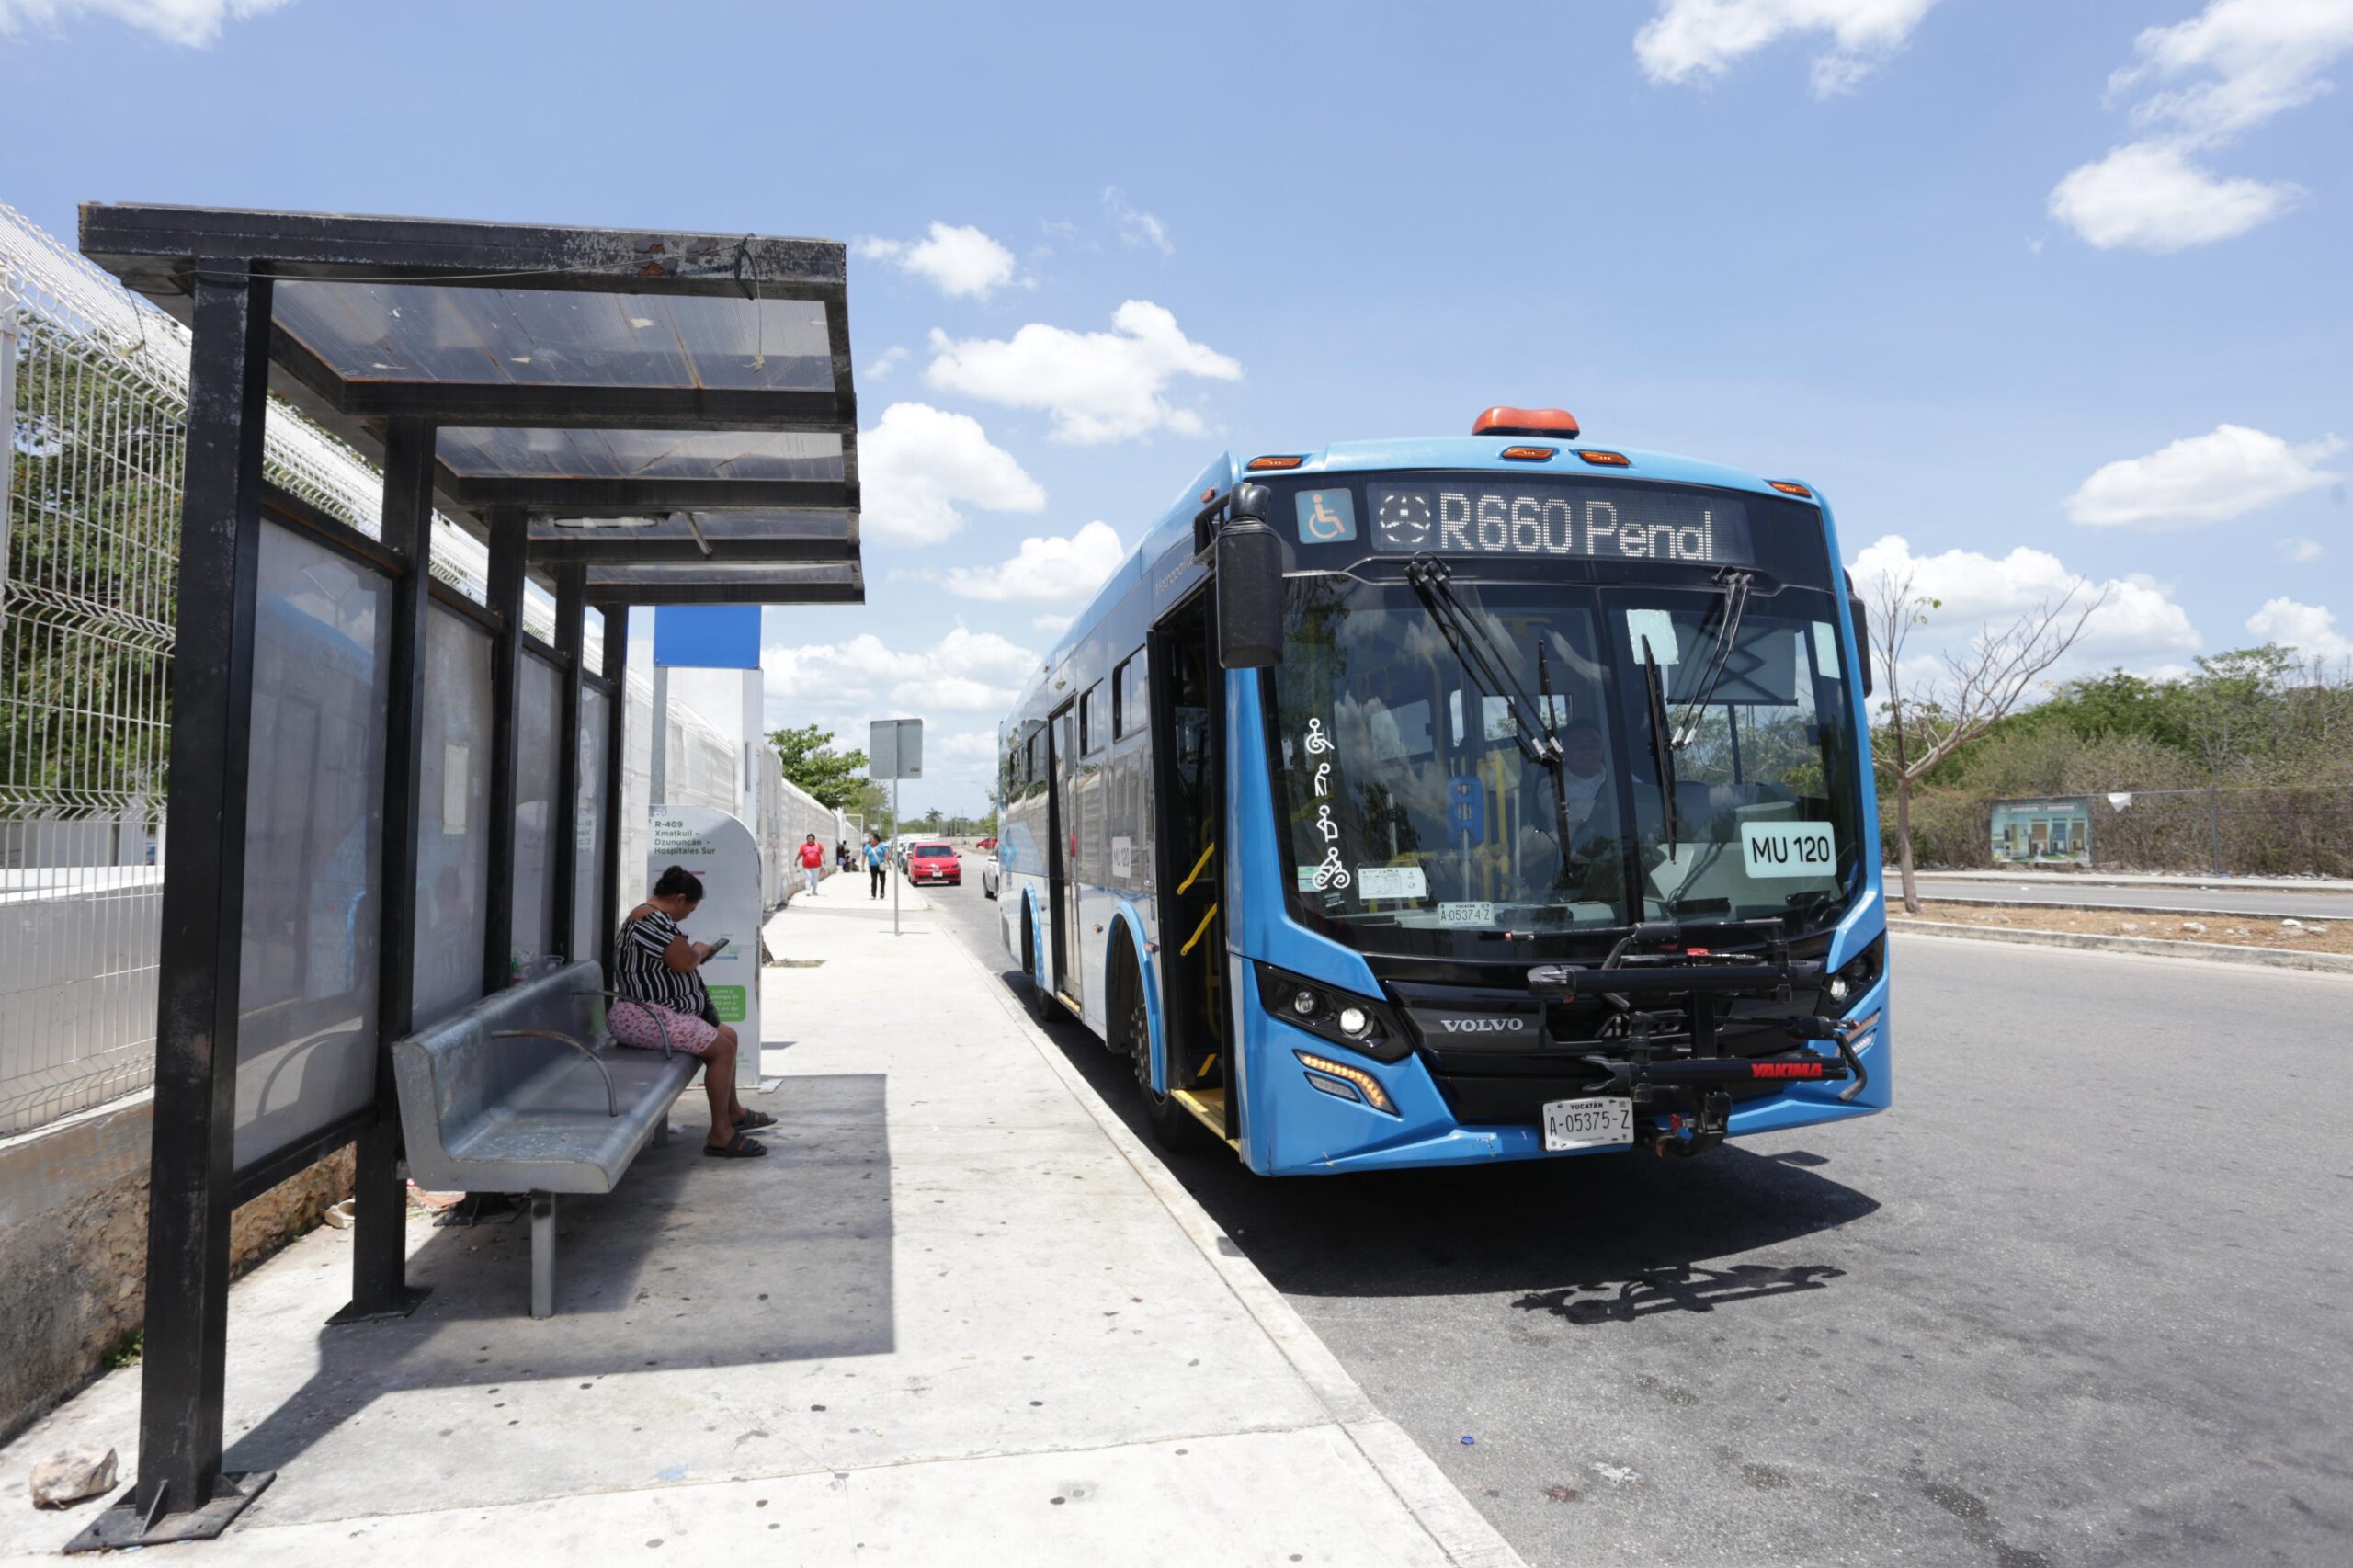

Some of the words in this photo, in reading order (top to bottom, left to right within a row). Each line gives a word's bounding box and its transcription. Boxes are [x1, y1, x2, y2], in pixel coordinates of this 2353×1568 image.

[1440, 492, 1573, 553] R660
[1586, 501, 1712, 561] Penal
[1752, 837, 1788, 863] MU
[1793, 836, 1830, 862] 120
[1440, 1018, 1524, 1032] VOLVO
[1751, 1062, 1823, 1078] YAKIMA
[1570, 1102, 1603, 1110] YUCATÁN
[1550, 1109, 1630, 1137] A-05375-Z
